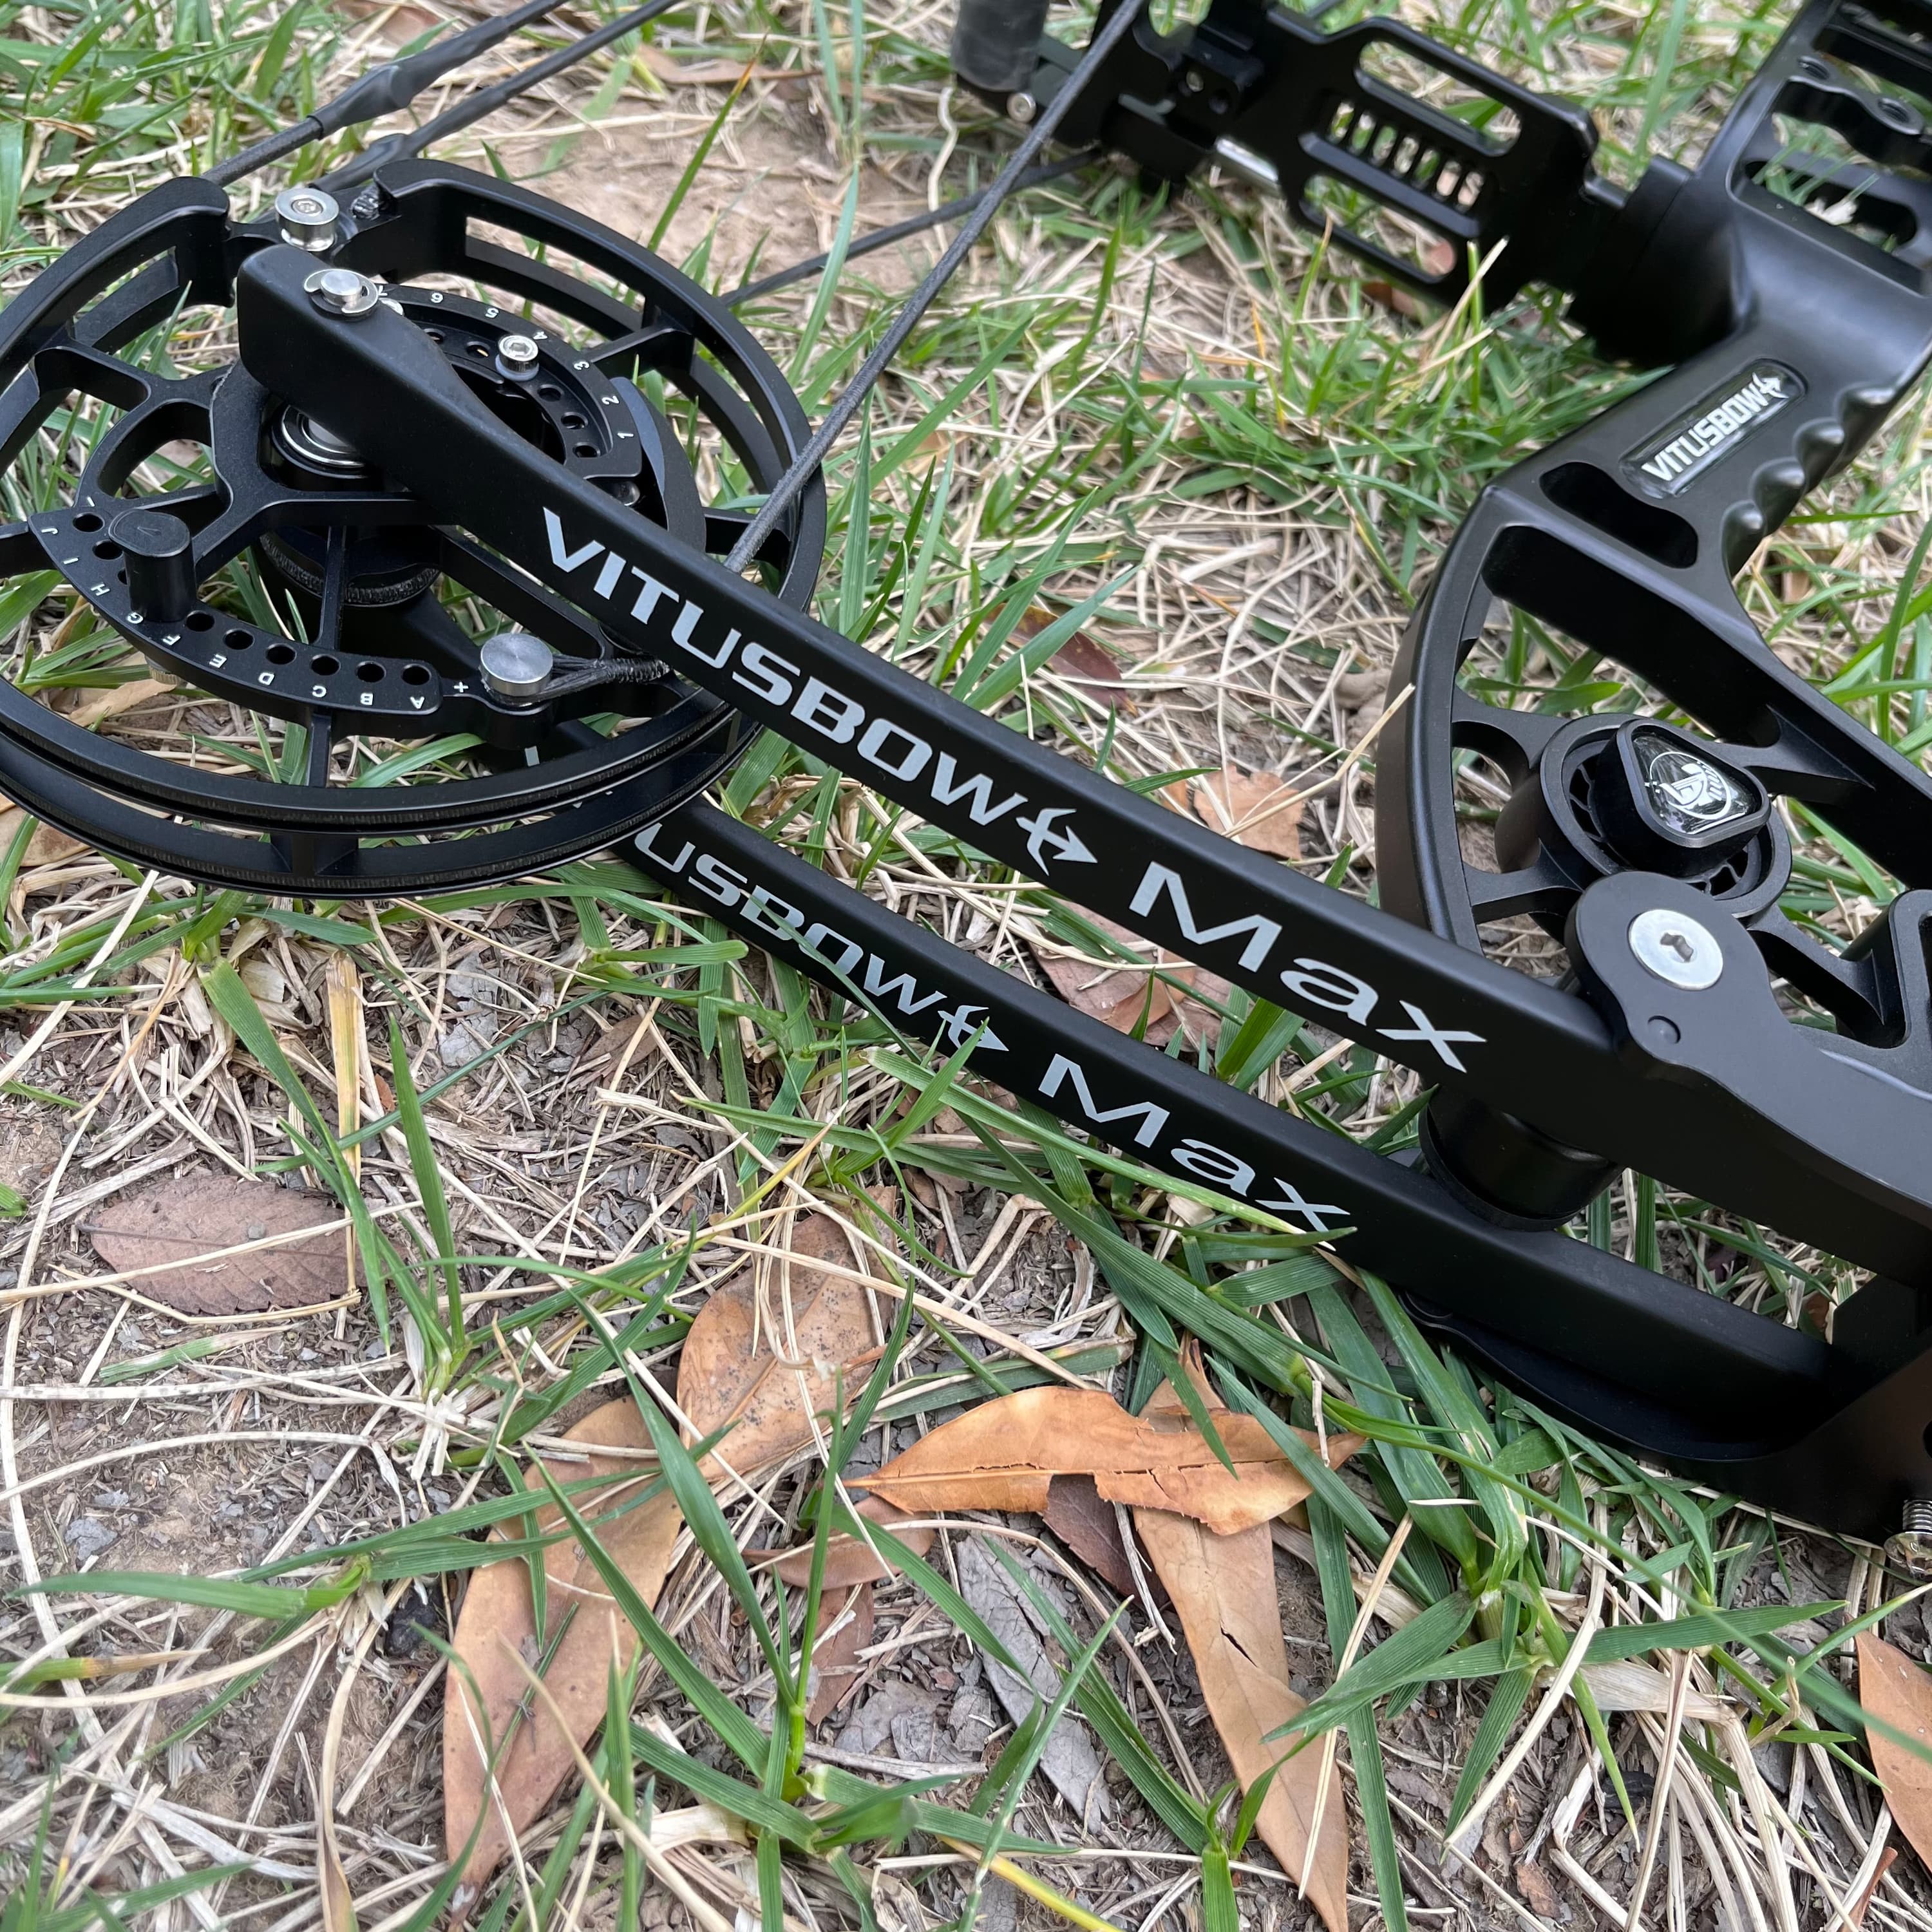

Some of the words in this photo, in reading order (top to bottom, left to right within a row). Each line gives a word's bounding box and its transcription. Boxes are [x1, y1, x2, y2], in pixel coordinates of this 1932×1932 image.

[430, 292, 444, 303] 6
[485, 306, 499, 318] 5
[533, 330, 548, 340] 4
[573, 360, 590, 370] 3
[601, 395, 620, 405] 2
[617, 431, 634, 439] 1
[1642, 383, 1769, 482] VITUSBOW
[41, 527, 59, 535] J
[90, 582, 110, 596] H
[126, 612, 144, 624] G
[162, 634, 181, 646] F
[209, 654, 227, 668] E
[258, 672, 275, 686] D
[312, 685, 327, 698] C
[360, 692, 374, 706] B
[410, 696, 425, 709] A
[544, 507, 1028, 826] VITUSBOW
[1129, 860, 1487, 1074] Max
[634, 822, 948, 1016] USBOW
[1038, 1053, 1350, 1232] Max
